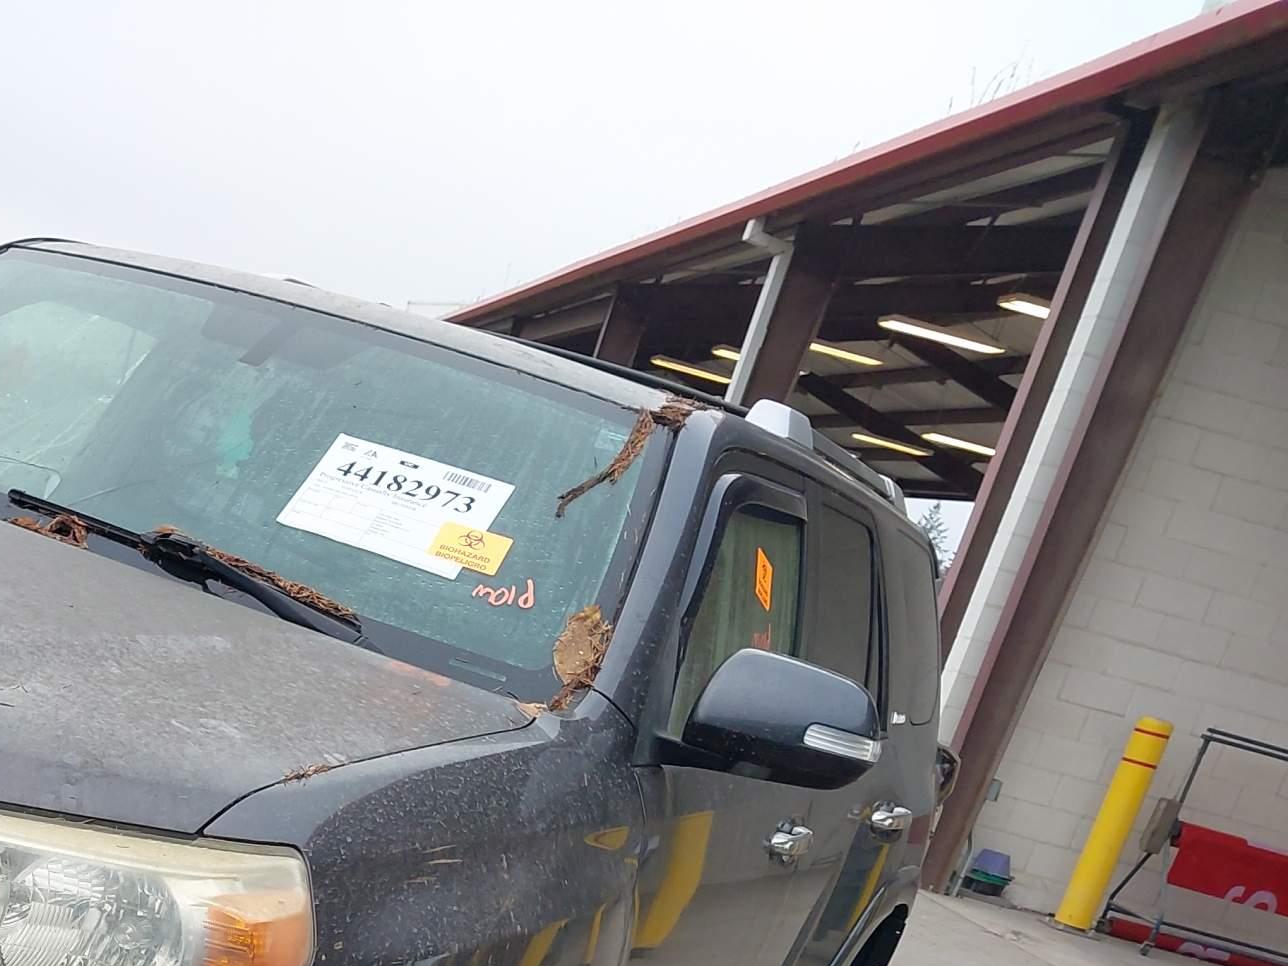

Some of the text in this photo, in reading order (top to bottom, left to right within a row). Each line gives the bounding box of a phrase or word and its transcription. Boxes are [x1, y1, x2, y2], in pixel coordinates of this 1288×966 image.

[336, 460, 477, 514] 44182973
[434, 551, 488, 571] BIOPELIGRO
[439, 544, 491, 564] BIOHAZARD
[471, 578, 536, 609] mold
